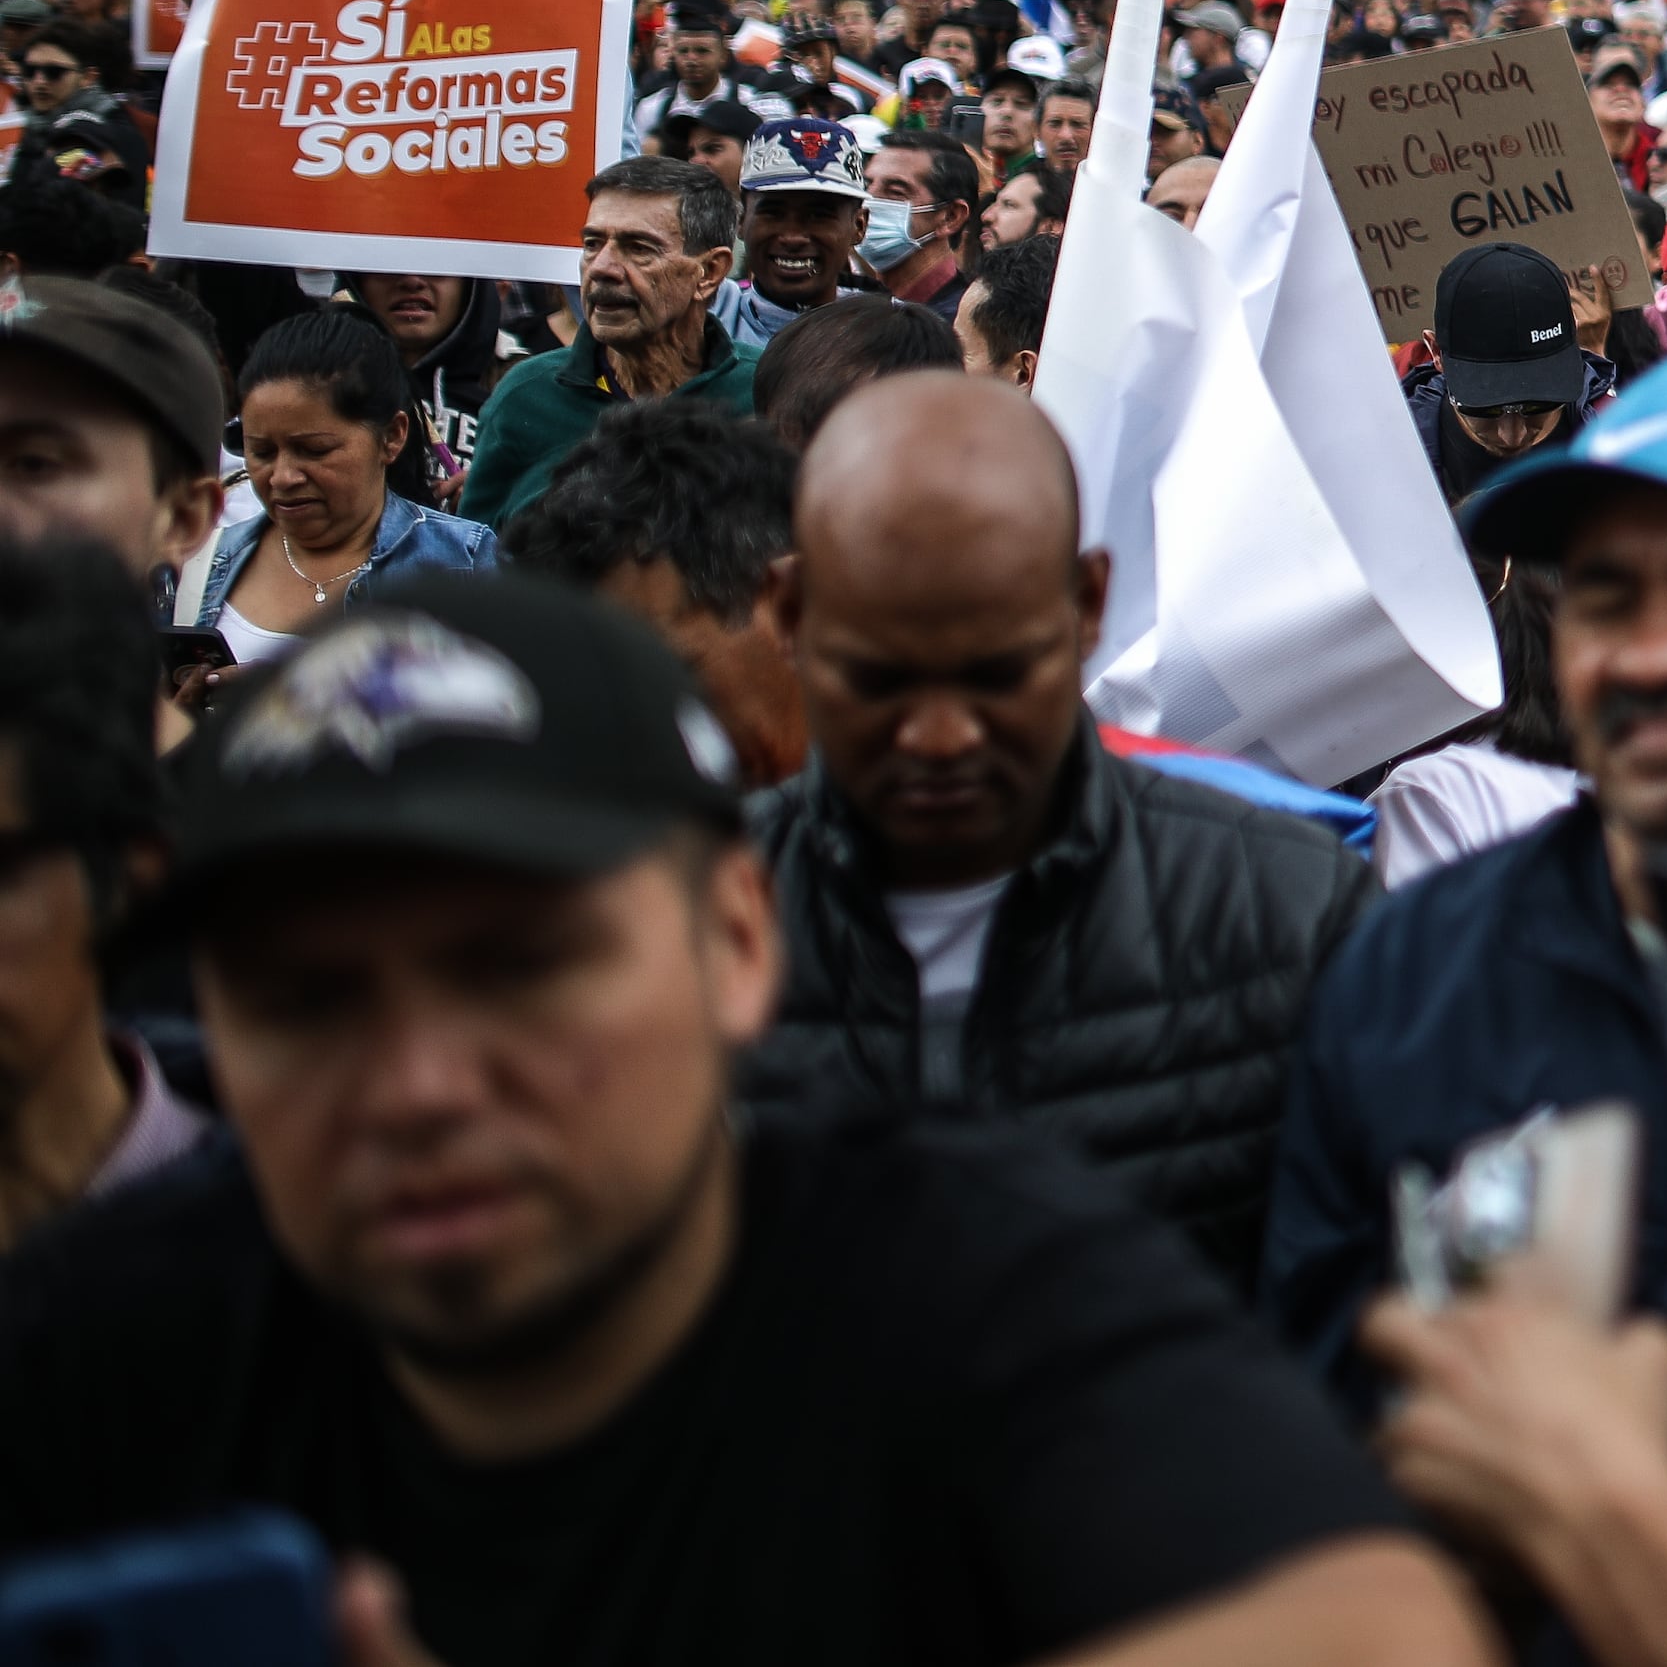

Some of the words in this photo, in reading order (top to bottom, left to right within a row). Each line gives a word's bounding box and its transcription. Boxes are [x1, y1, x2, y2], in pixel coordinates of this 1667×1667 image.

[294, 65, 568, 117] Reformas
[1368, 49, 1536, 119] escapada
[291, 109, 570, 179] Sociales
[1353, 158, 1399, 190] mi
[1449, 168, 1575, 236] GALAN
